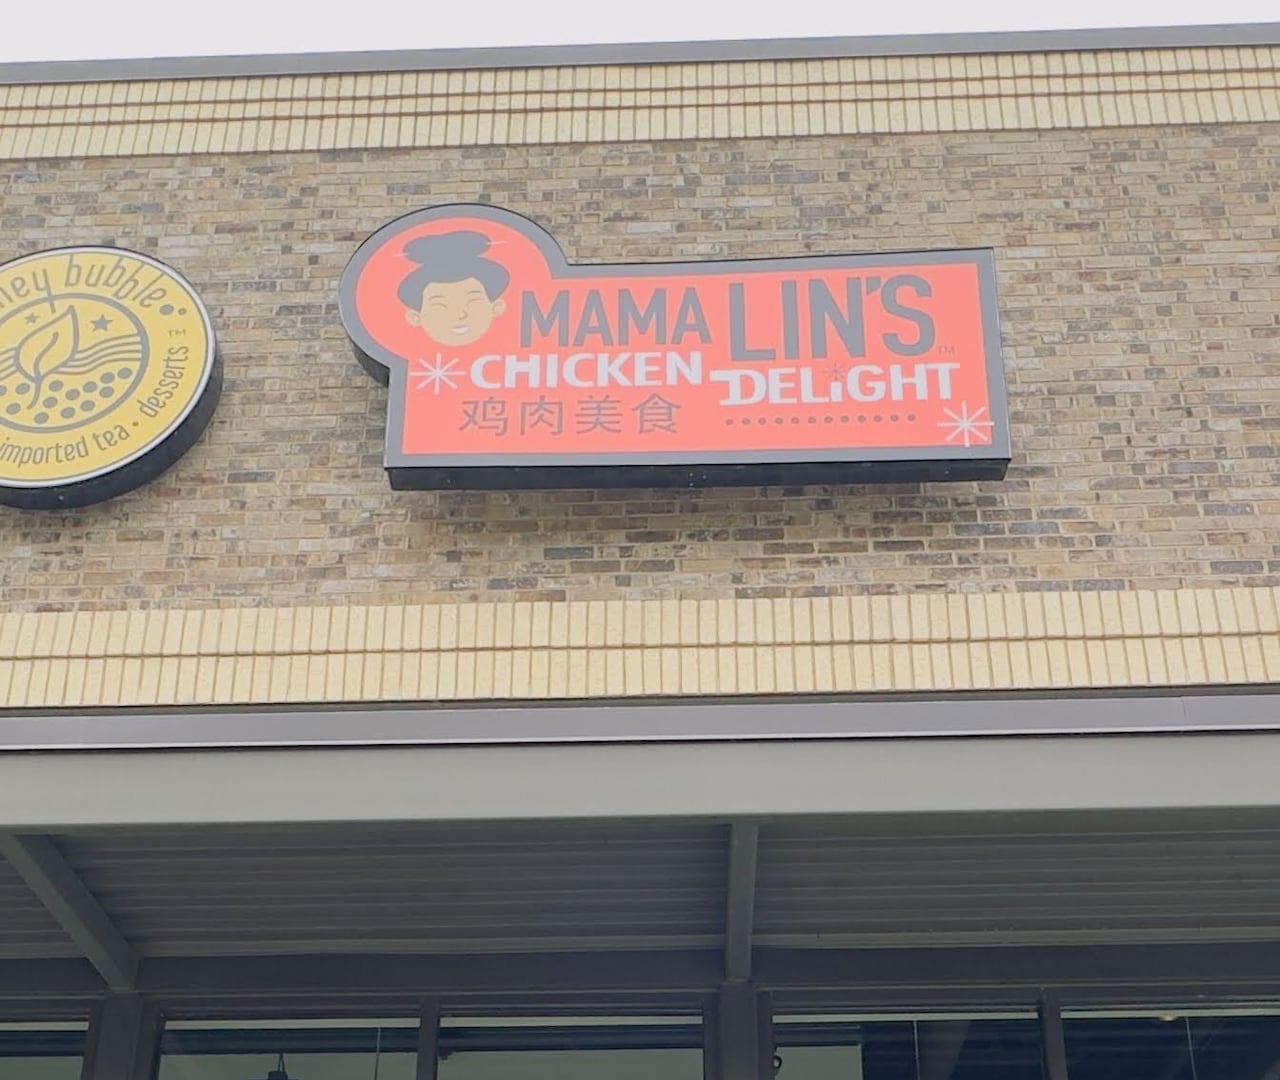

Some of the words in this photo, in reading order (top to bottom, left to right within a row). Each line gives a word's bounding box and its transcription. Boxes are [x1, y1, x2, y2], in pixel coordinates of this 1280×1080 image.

[64, 254, 167, 310] bubble
[520, 287, 712, 347] MAMA
[728, 275, 935, 362] LIN'S
[469, 351, 703, 389] CHICKEN
[92, 424, 130, 452] tea
[138, 345, 190, 419] desserts
[459, 392, 682, 436] 鸡肉美食
